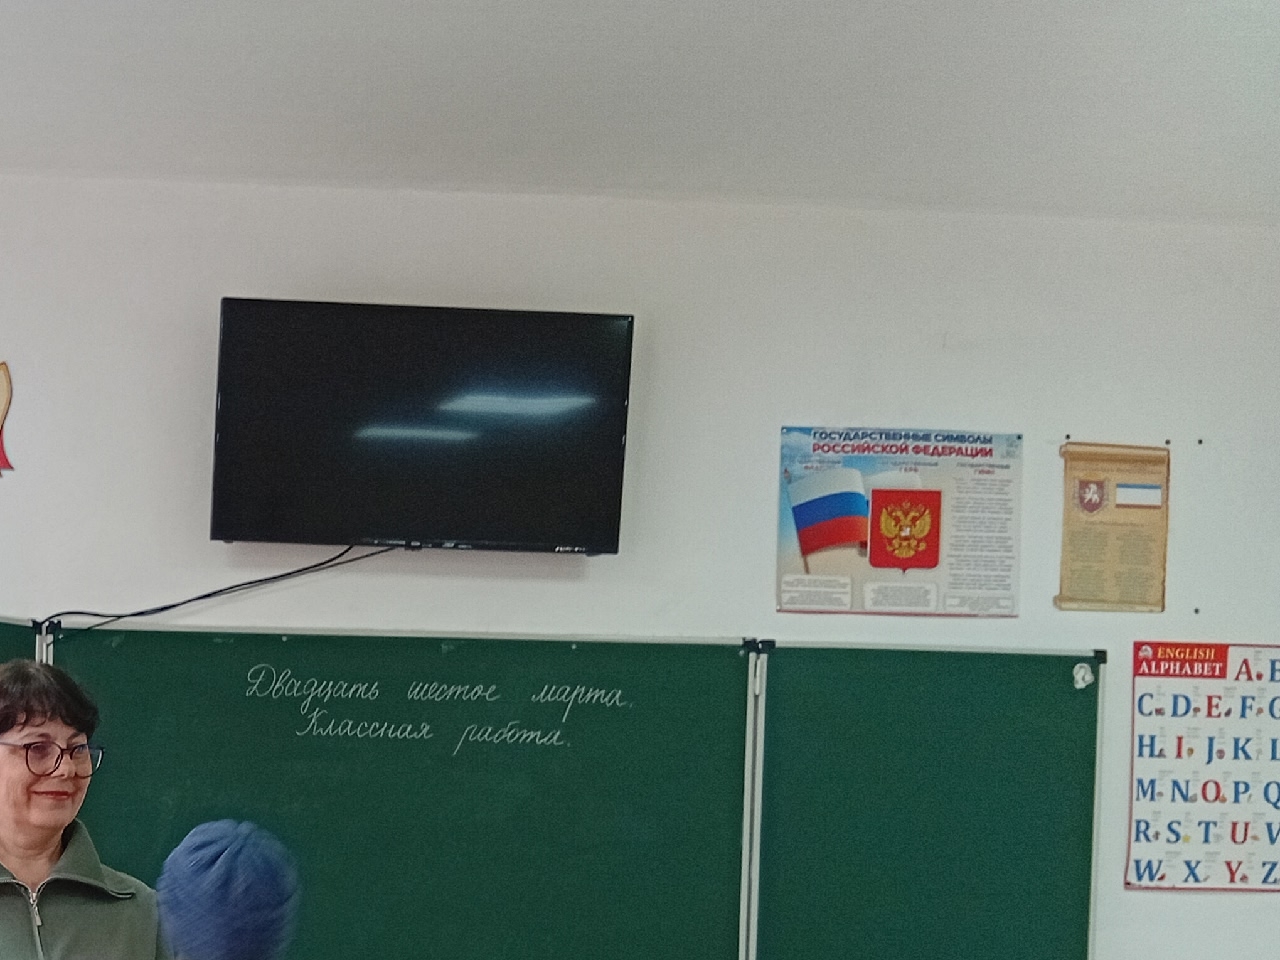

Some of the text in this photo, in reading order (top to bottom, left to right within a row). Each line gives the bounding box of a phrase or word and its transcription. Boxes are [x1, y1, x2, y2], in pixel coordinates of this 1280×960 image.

[812, 429, 993, 445] ГОСУДАРСТВЕННЫЕ СИМВОЛЫ
[812, 440, 994, 460] РОССИЙСКОЙ ФЕДЕРАЦИИ
[1157, 646, 1216, 661] ENGLISH
[1138, 661, 1223, 676] ALPHABET
[1234, 658, 1253, 682] A
[246, 663, 381, 715] Двадцать
[407, 680, 502, 703] шестое
[1137, 692, 1154, 717] C
[1170, 694, 1192, 718] D
[1205, 694, 1223, 719] E
[1239, 695, 1256, 719] F
[295, 706, 434, 740] Классная
[1137, 734, 1157, 758] H
[1175, 735, 1184, 760] I
[1206, 736, 1216, 765] J
[1232, 737, 1253, 761] K
[1135, 777, 1280, 810] M N O P Q
[1134, 818, 1152, 843] R
[1166, 819, 1183, 844] S
[1197, 820, 1218, 844] T
[1230, 820, 1251, 845] U
[1133, 859, 1280, 885] W X Y Z
